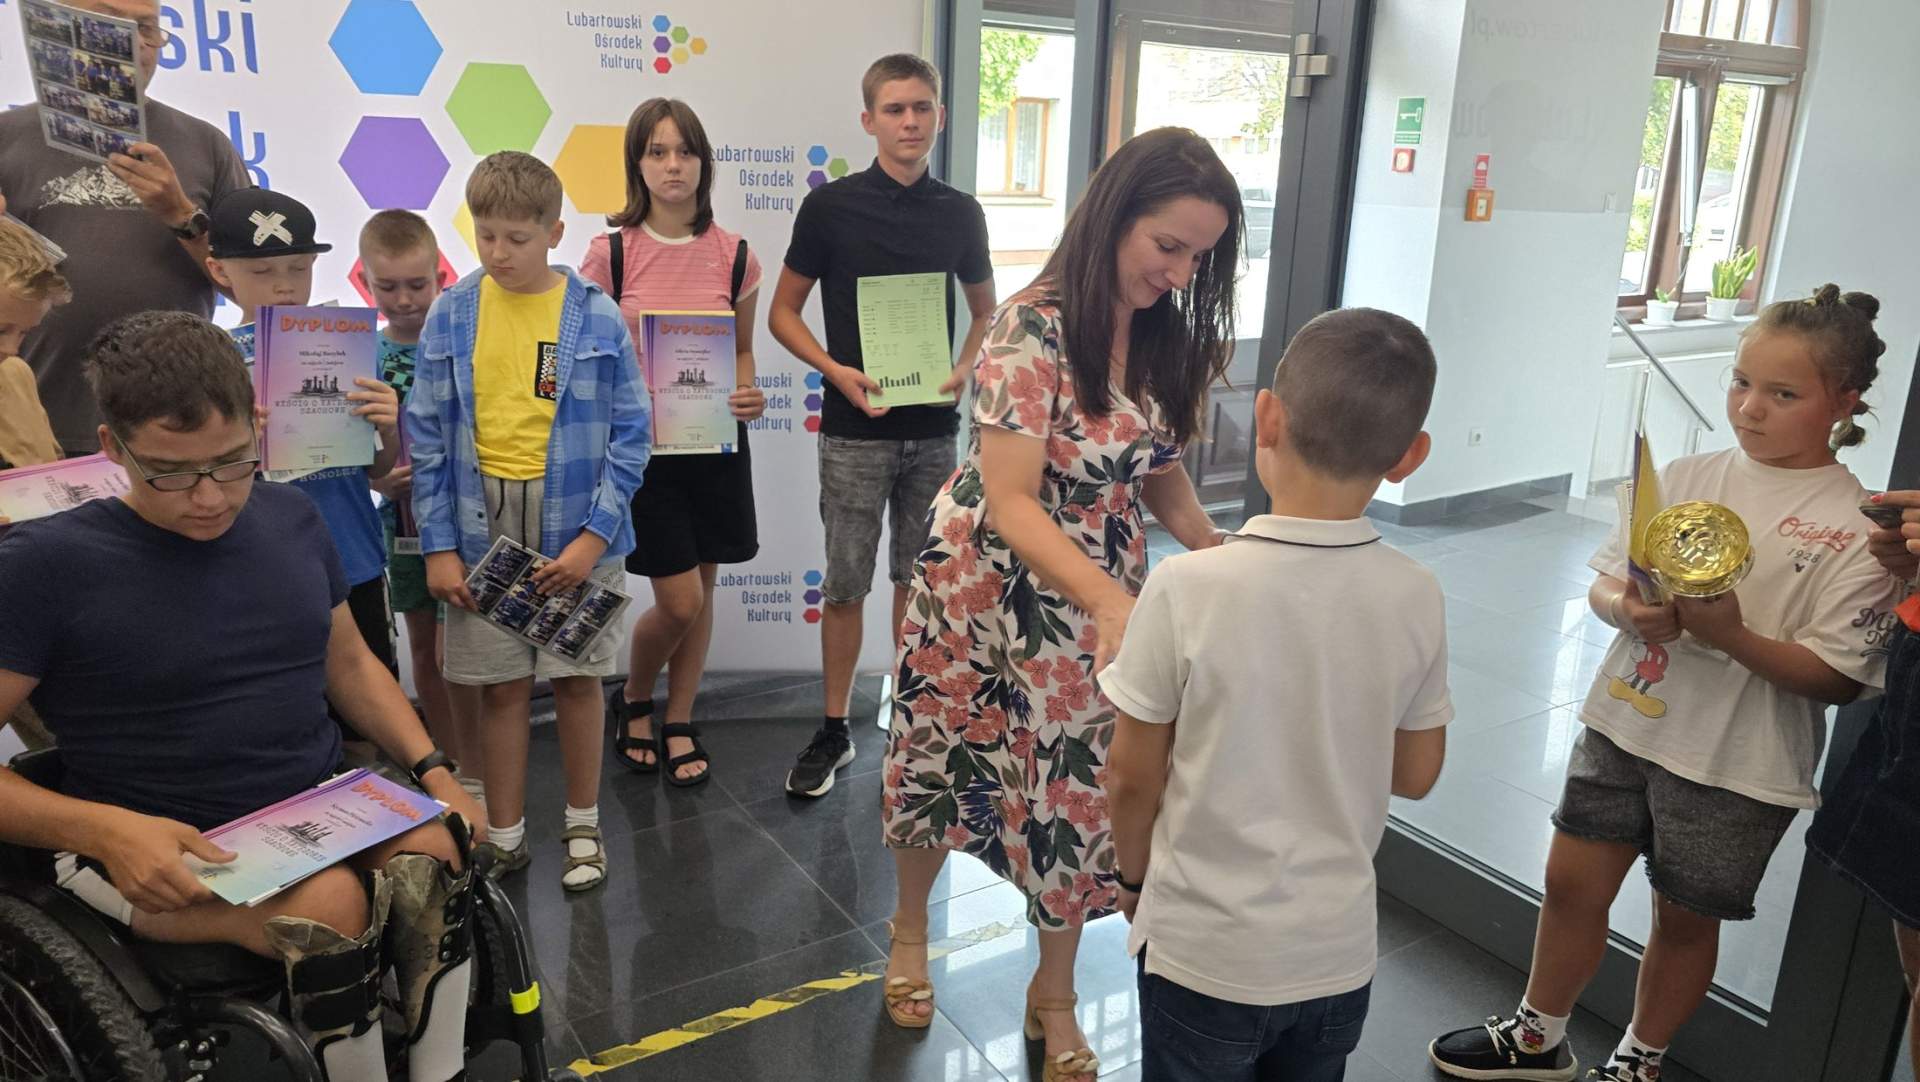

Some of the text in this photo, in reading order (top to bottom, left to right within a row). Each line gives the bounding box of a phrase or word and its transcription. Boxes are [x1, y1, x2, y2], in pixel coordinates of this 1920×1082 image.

[566, 11, 642, 29] Lubartowski
[158, 0, 258, 74] ski
[594, 33, 642, 49] Ośrodek
[600, 53, 642, 72] Kultury
[713, 144, 795, 163] ubartowski
[740, 169, 794, 187] Ośrodek
[745, 193, 794, 214] Kultury
[281, 315, 372, 333] DYPLOM
[754, 372, 792, 388] owski
[1786, 548, 1821, 563] 1928
[742, 590, 792, 604] Ośrodek
[747, 608, 792, 623] Kultury
[1852, 607, 1894, 632] Mi
